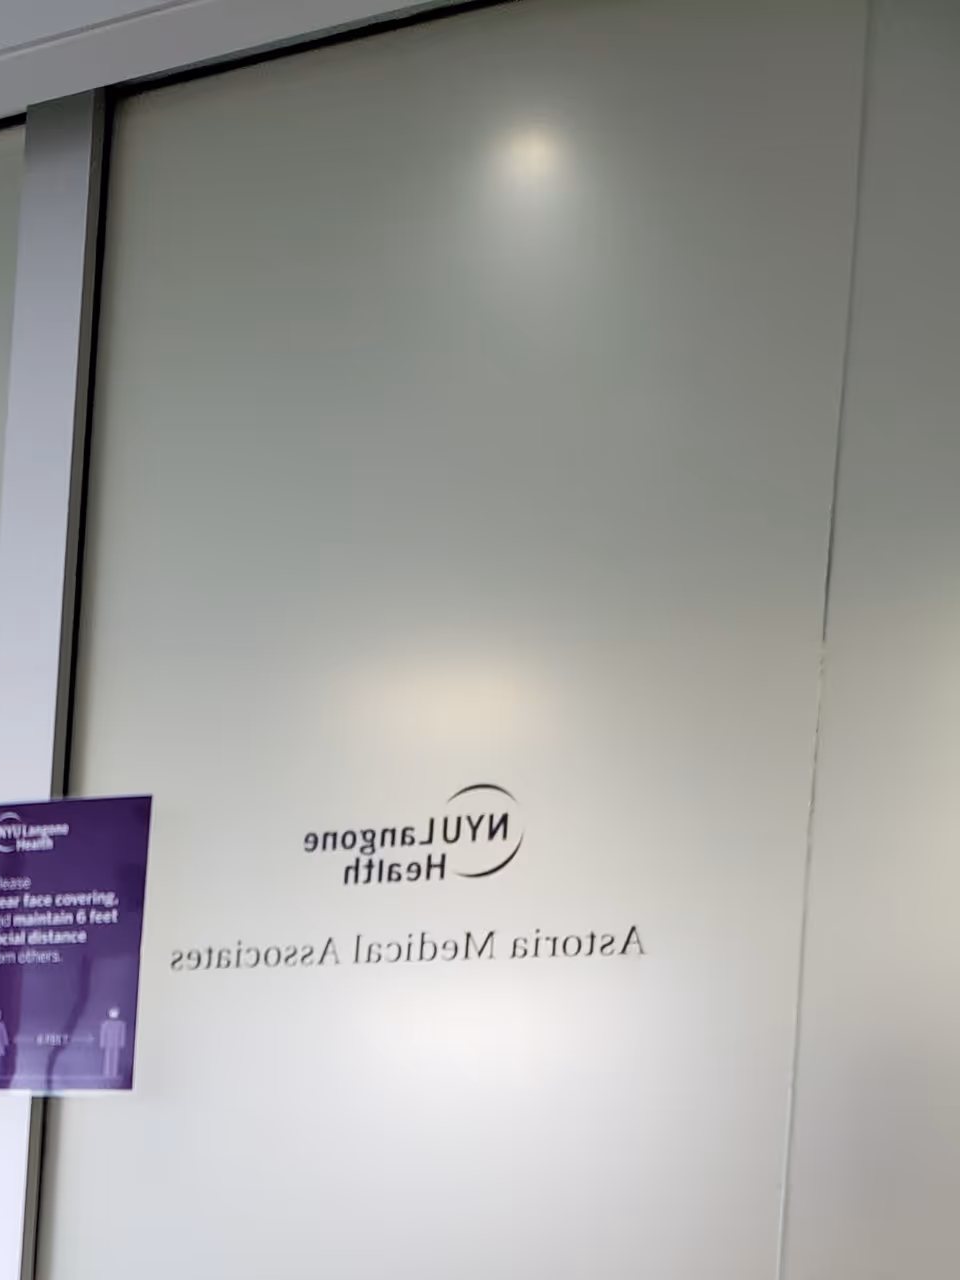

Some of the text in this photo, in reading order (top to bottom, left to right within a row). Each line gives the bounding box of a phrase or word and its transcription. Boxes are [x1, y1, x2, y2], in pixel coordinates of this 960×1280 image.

[16, 838, 54, 852] Health
[23, 892, 53, 907] face
[12, 911, 74, 926] maintain
[76, 908, 87, 924] 6
[89, 908, 118, 924] feet
[27, 928, 87, 945] distance
